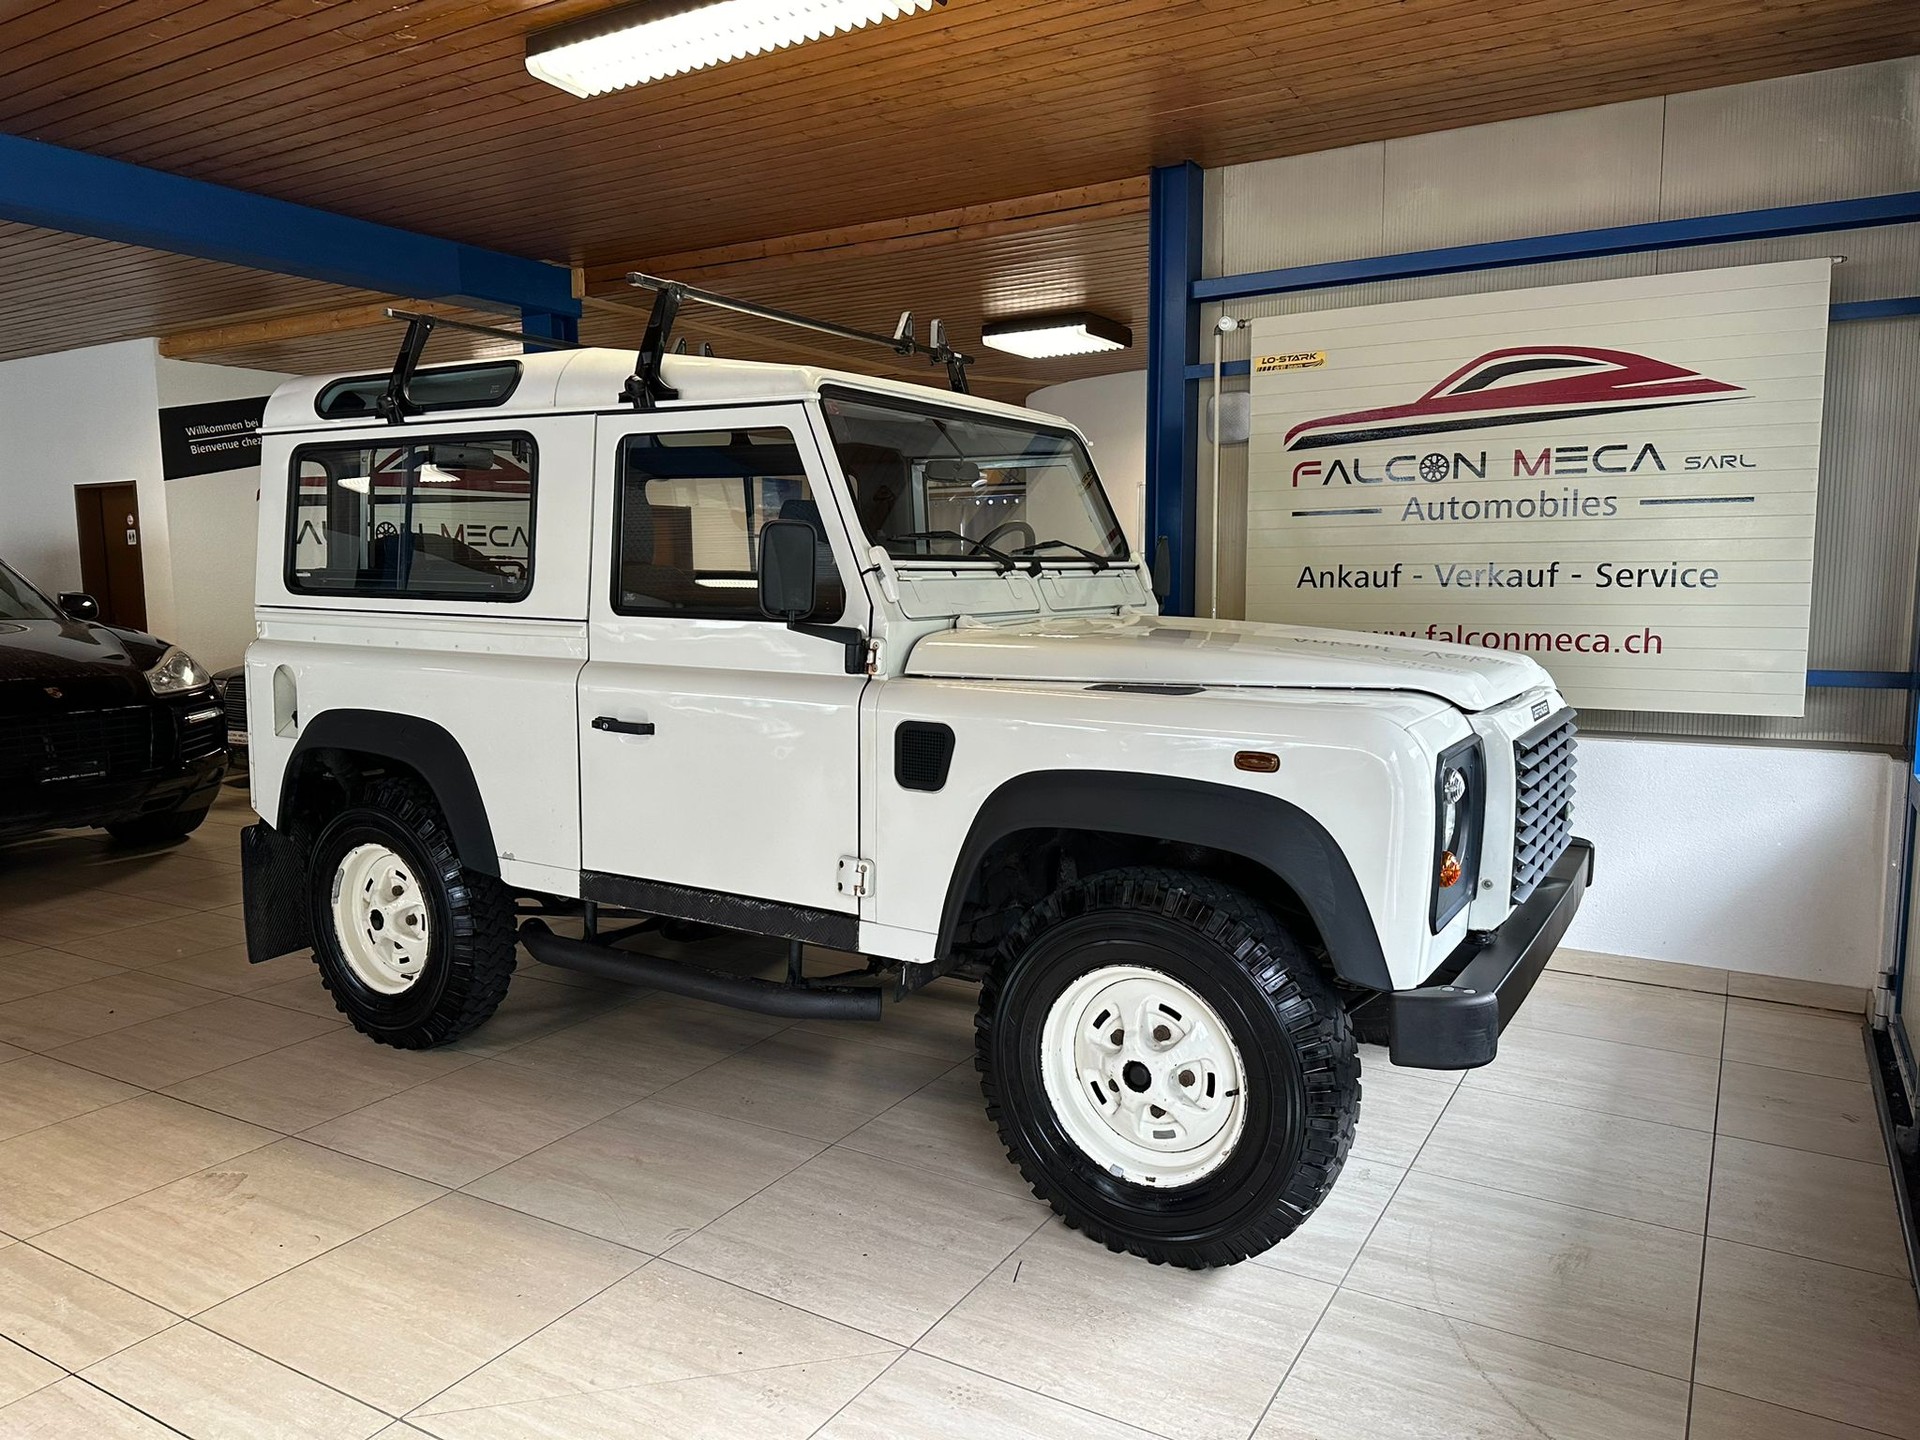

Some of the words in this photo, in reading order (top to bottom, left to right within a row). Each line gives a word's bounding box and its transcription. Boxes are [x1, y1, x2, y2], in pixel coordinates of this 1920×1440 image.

[1261, 352, 1317, 364] LO-STARK
[185, 422, 243, 436] Willkommen
[244, 418, 259, 428] bei
[190, 441, 239, 454] Bienvenue
[241, 437, 262, 447] chez
[1292, 451, 1487, 487] FALCON
[1513, 442, 1667, 477] MECA
[1684, 454, 1757, 471] SARL
[1401, 487, 1617, 522] Automobiles
[441, 523, 529, 548] MECA
[1297, 563, 1403, 588] Ankauf
[1434, 561, 1560, 588] Verkauf
[1595, 561, 1720, 588] Service
